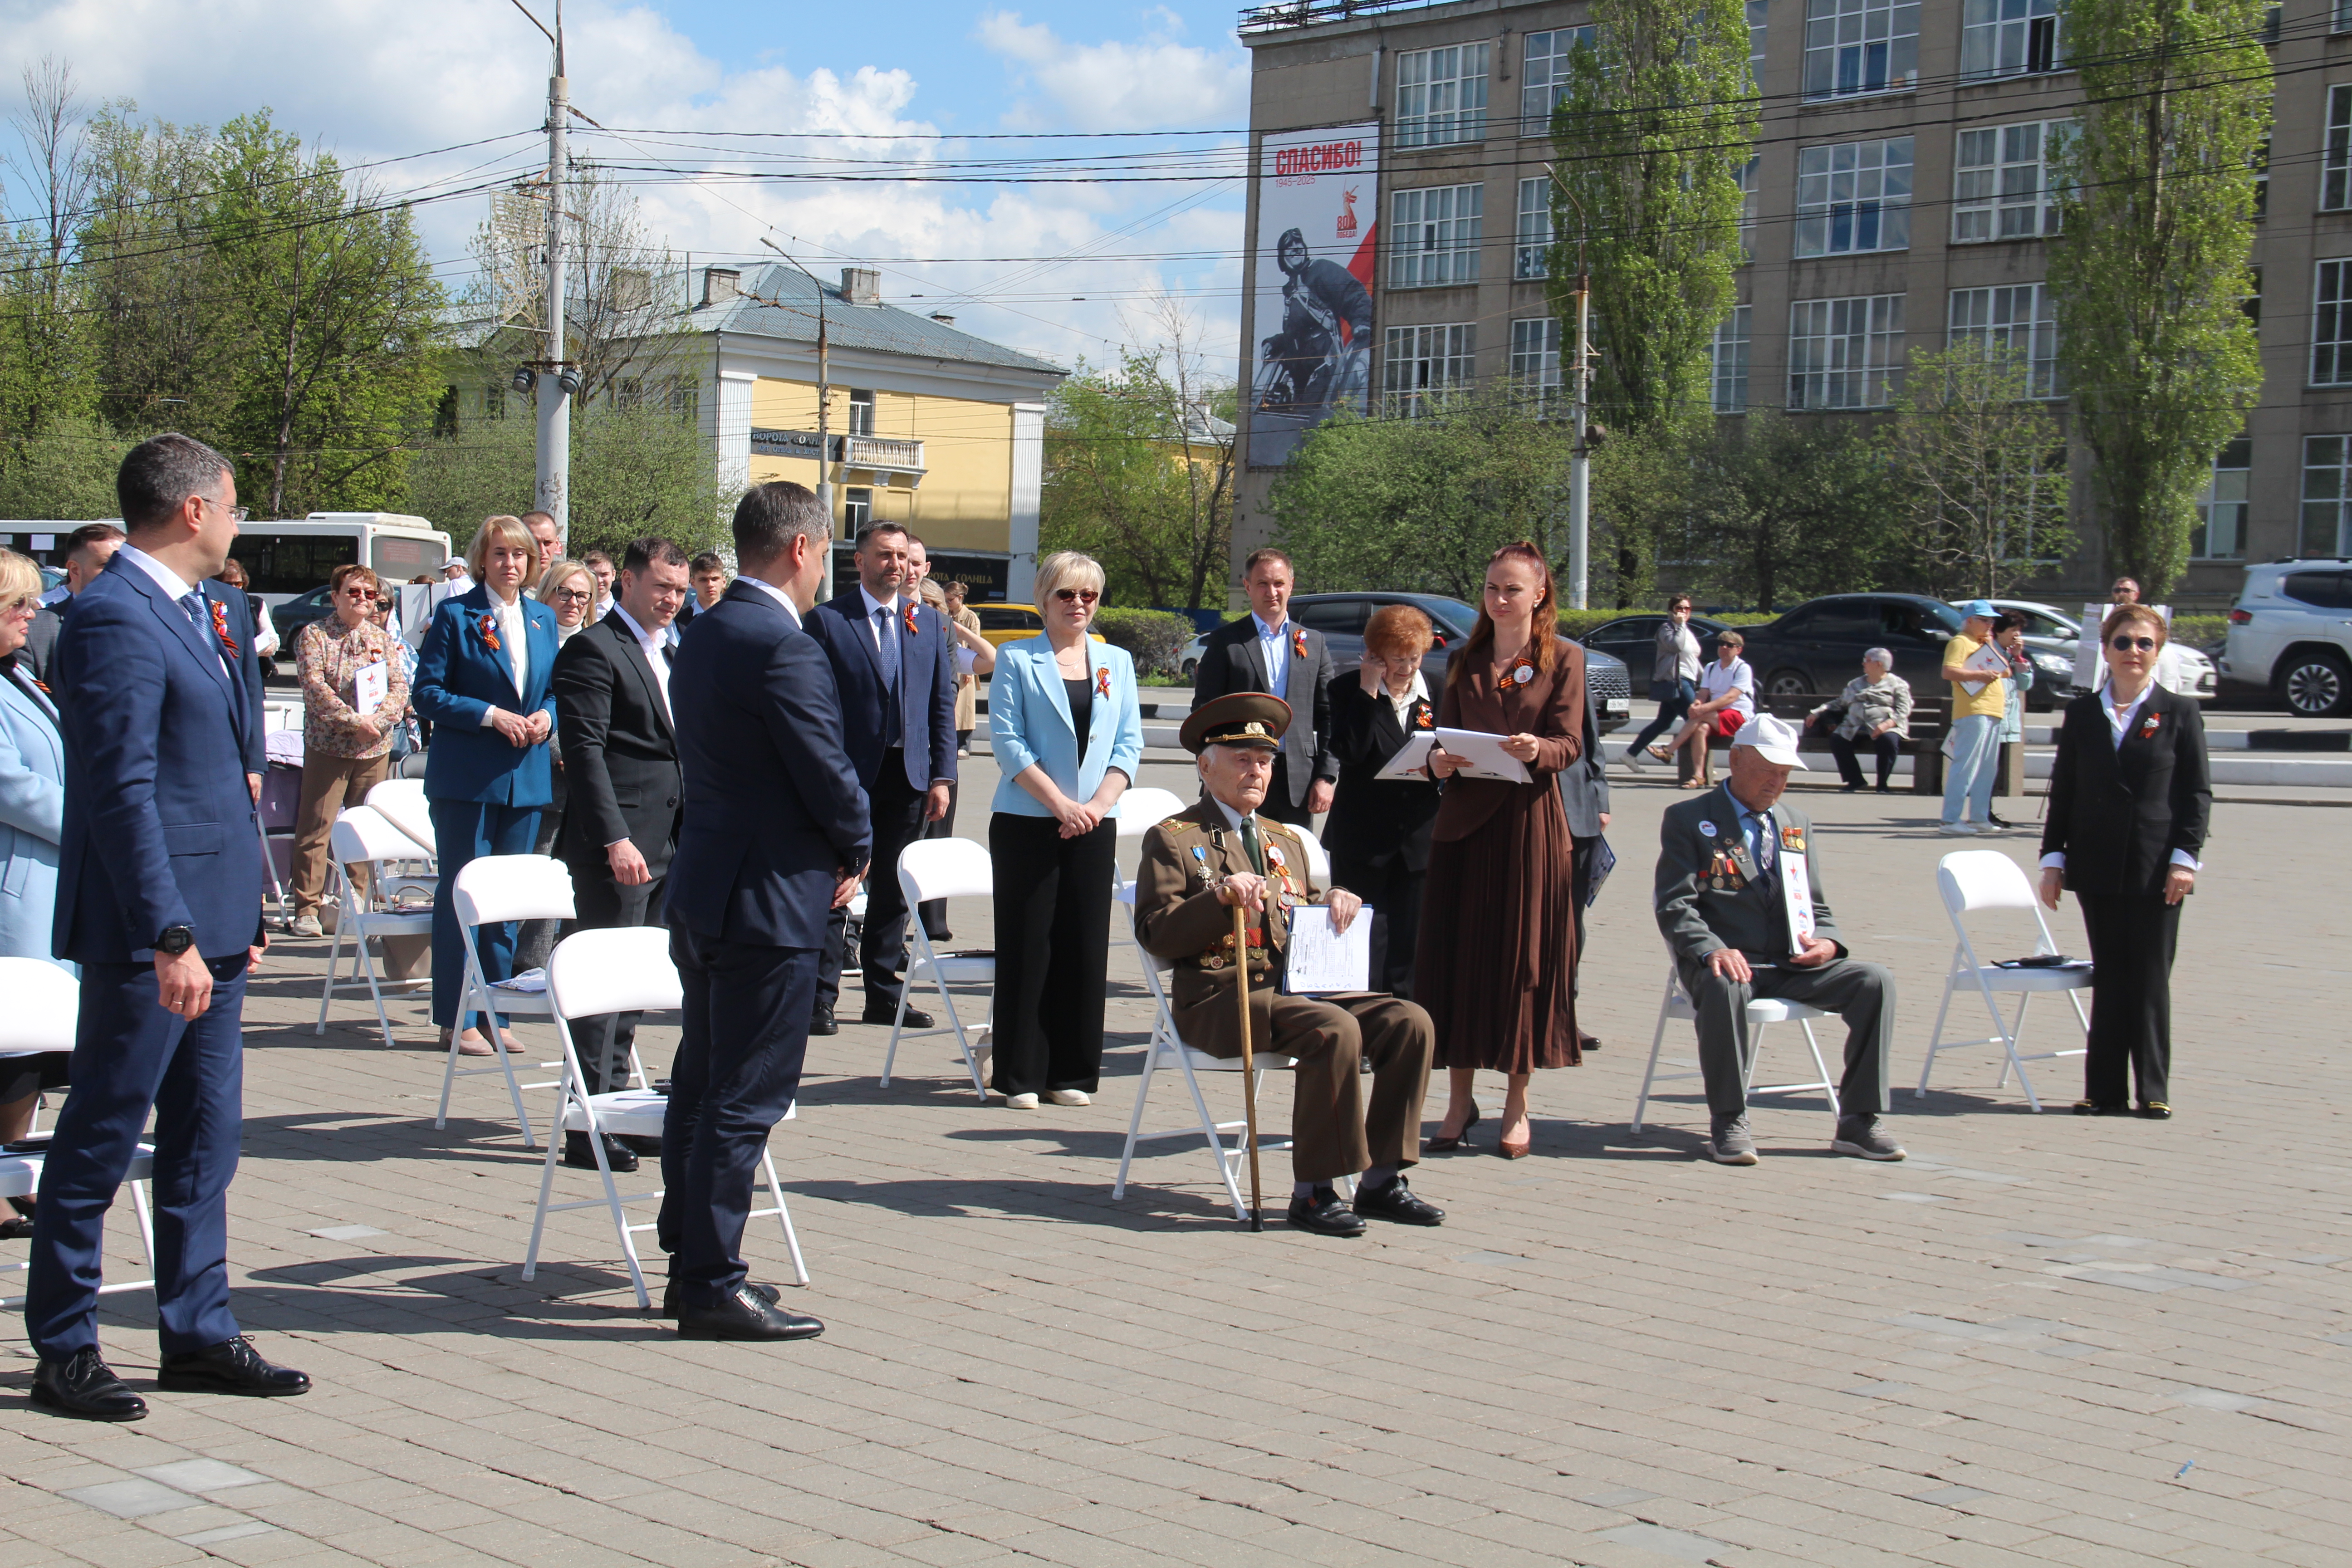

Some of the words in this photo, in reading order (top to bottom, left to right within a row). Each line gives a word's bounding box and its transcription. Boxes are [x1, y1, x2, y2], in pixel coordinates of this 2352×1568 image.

[1276, 141, 1361, 175] СПАСИБО!
[1337, 216, 1348, 229] 80
[753, 431, 789, 443] ВОРОТА
[956, 574, 993, 584] СОЛНЦА
